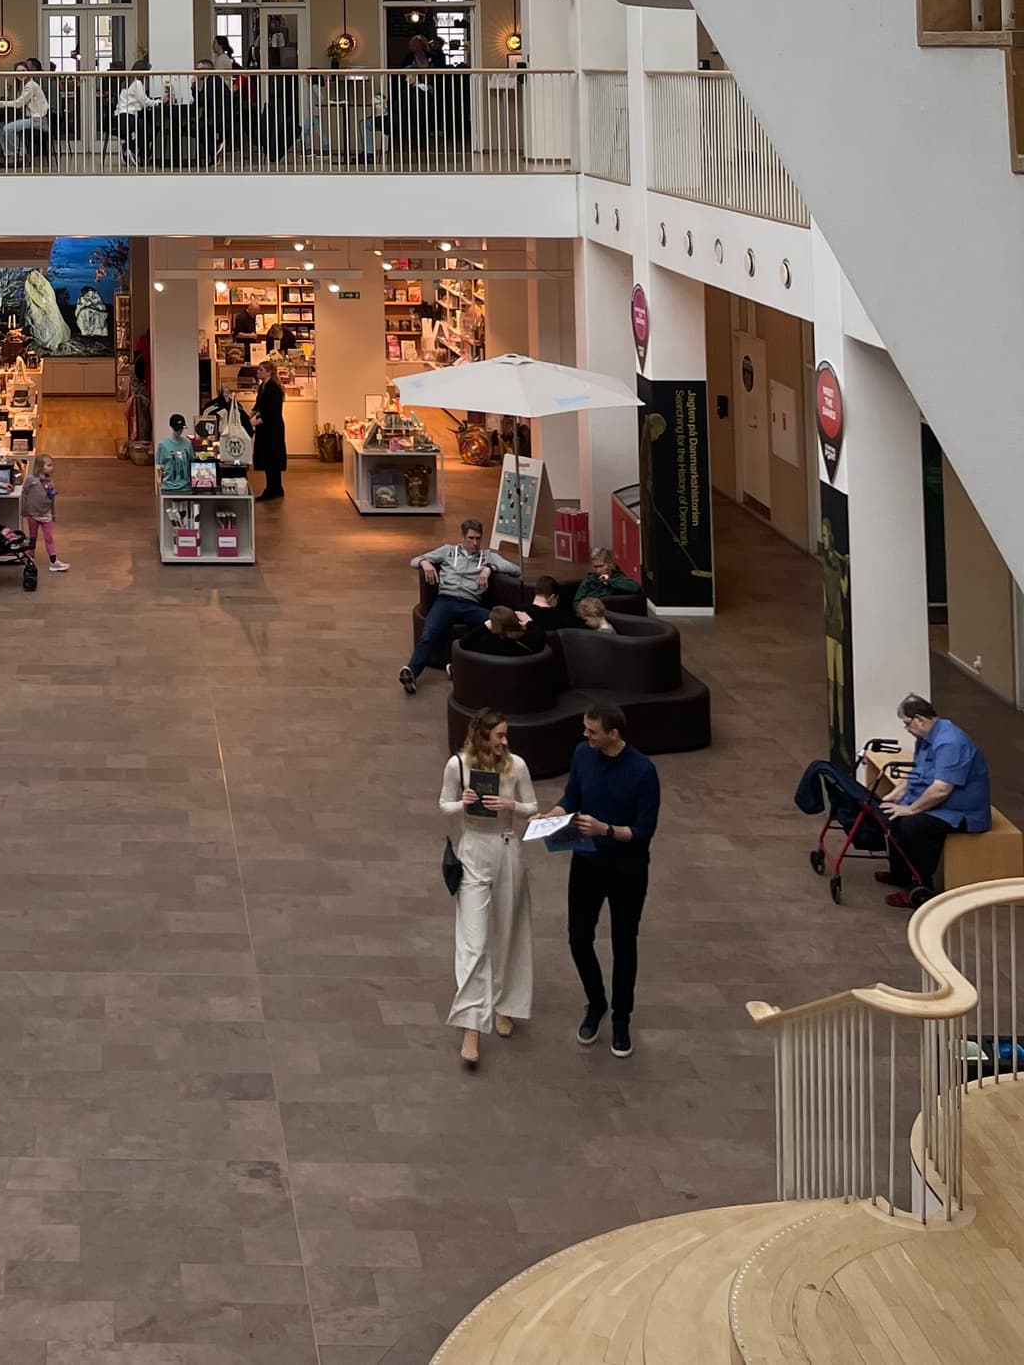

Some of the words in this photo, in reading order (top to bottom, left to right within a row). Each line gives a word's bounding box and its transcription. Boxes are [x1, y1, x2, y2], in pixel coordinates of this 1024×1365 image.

[675, 389, 685, 434] Searching
[687, 389, 697, 423] Jagten
[677, 435, 686, 447] for
[687, 424, 698, 436] på
[677, 448, 685, 463] the
[676, 464, 687, 495] History
[689, 437, 700, 526] Danmarkshistorien
[679, 496, 688, 505] of
[679, 506, 688, 545] Denmark
